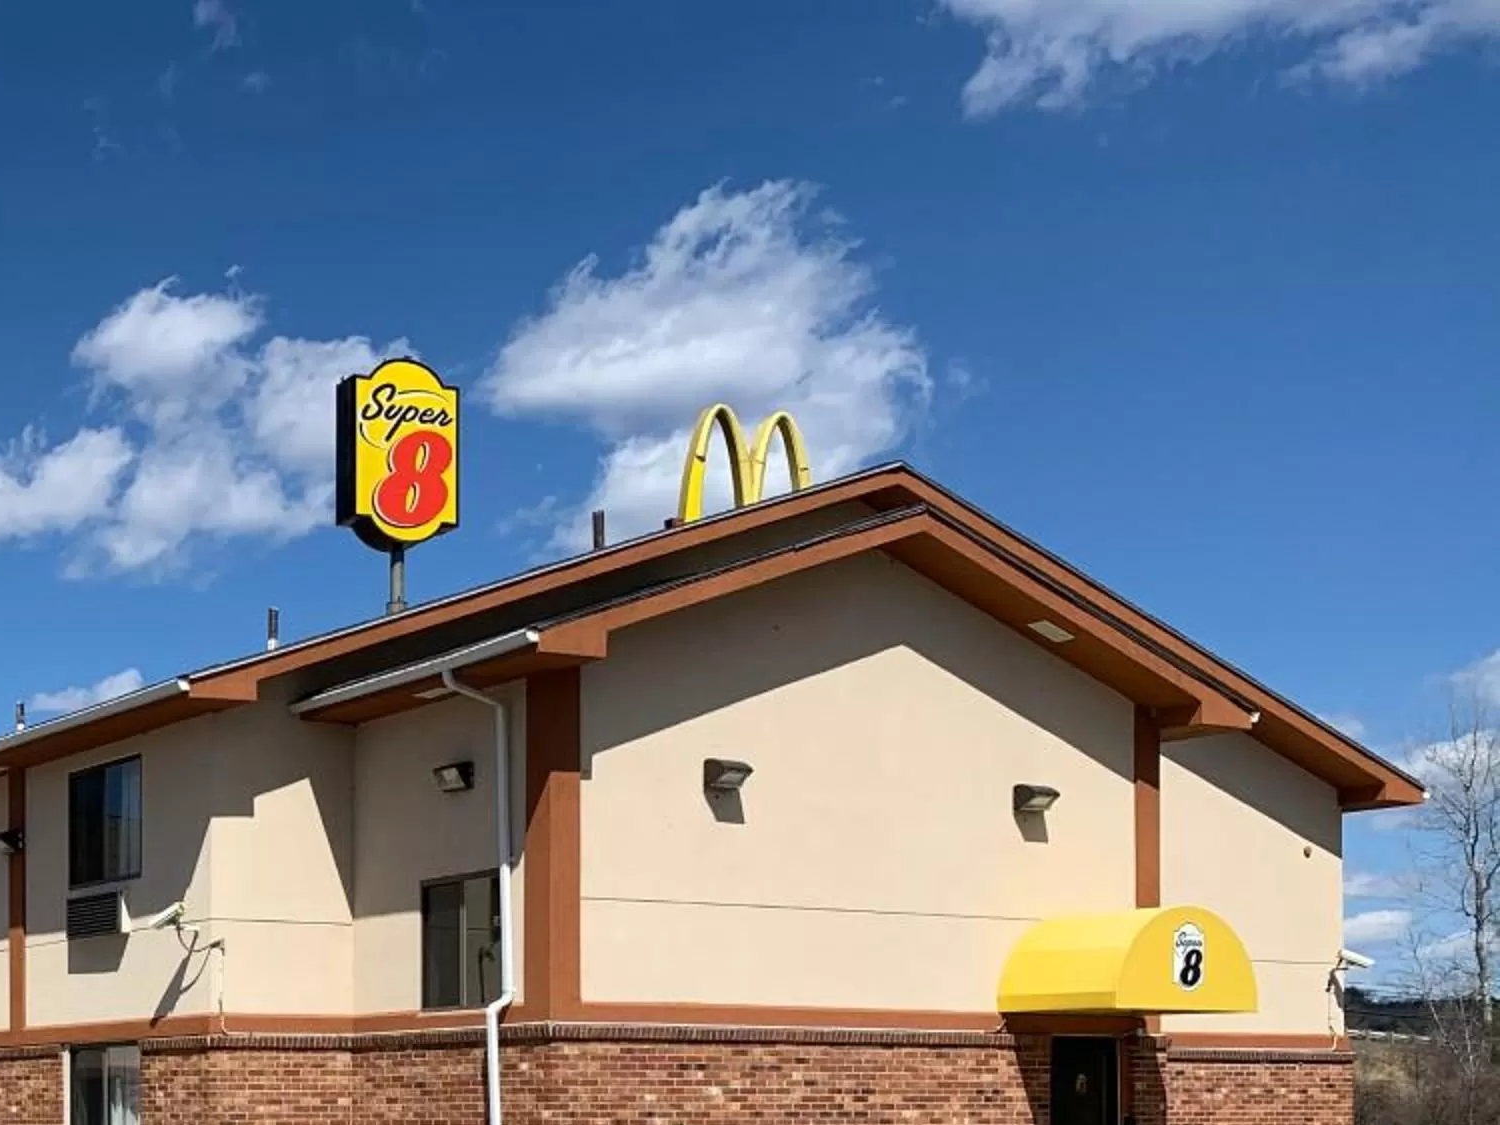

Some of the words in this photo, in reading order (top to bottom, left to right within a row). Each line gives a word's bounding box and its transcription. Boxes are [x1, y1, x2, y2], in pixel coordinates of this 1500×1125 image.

[361, 383, 453, 442] Super
[372, 429, 453, 528] 8
[1180, 949, 1203, 987] 8
